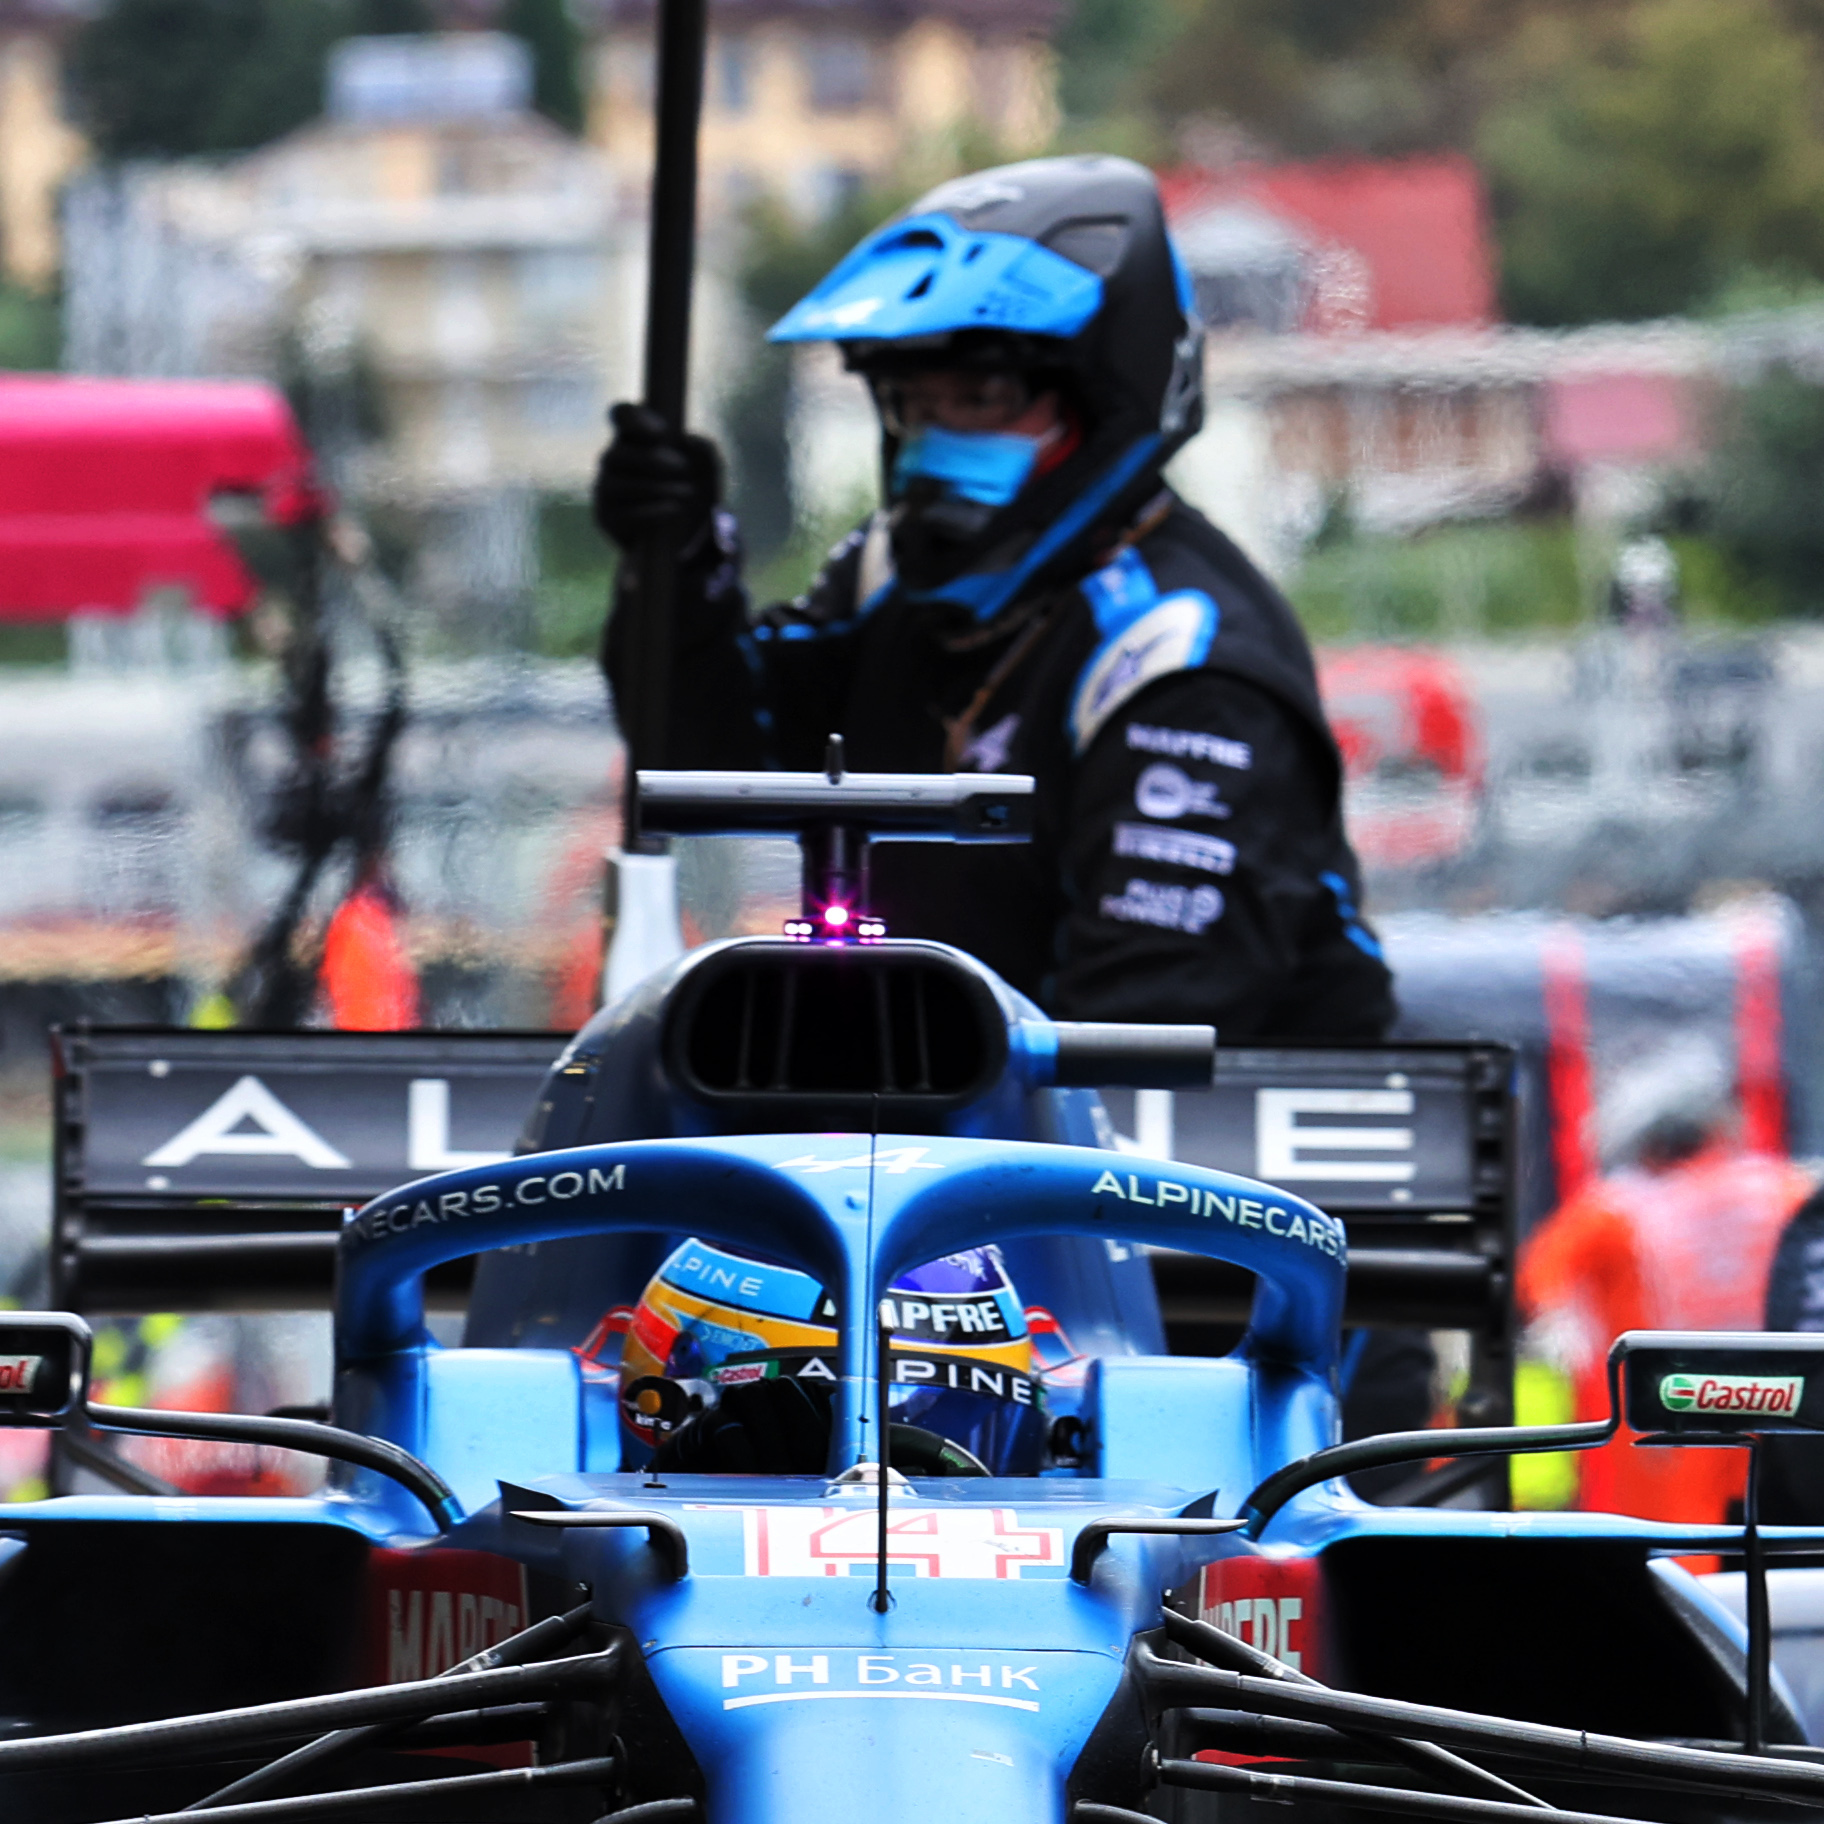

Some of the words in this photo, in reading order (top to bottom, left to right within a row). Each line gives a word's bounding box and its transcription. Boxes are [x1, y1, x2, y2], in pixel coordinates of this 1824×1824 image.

[1696, 1380, 1795, 1412] Castrol
[683, 1503, 1066, 1579] 14
[722, 1654, 830, 1688] РН
[857, 1655, 1040, 1692] Банк
